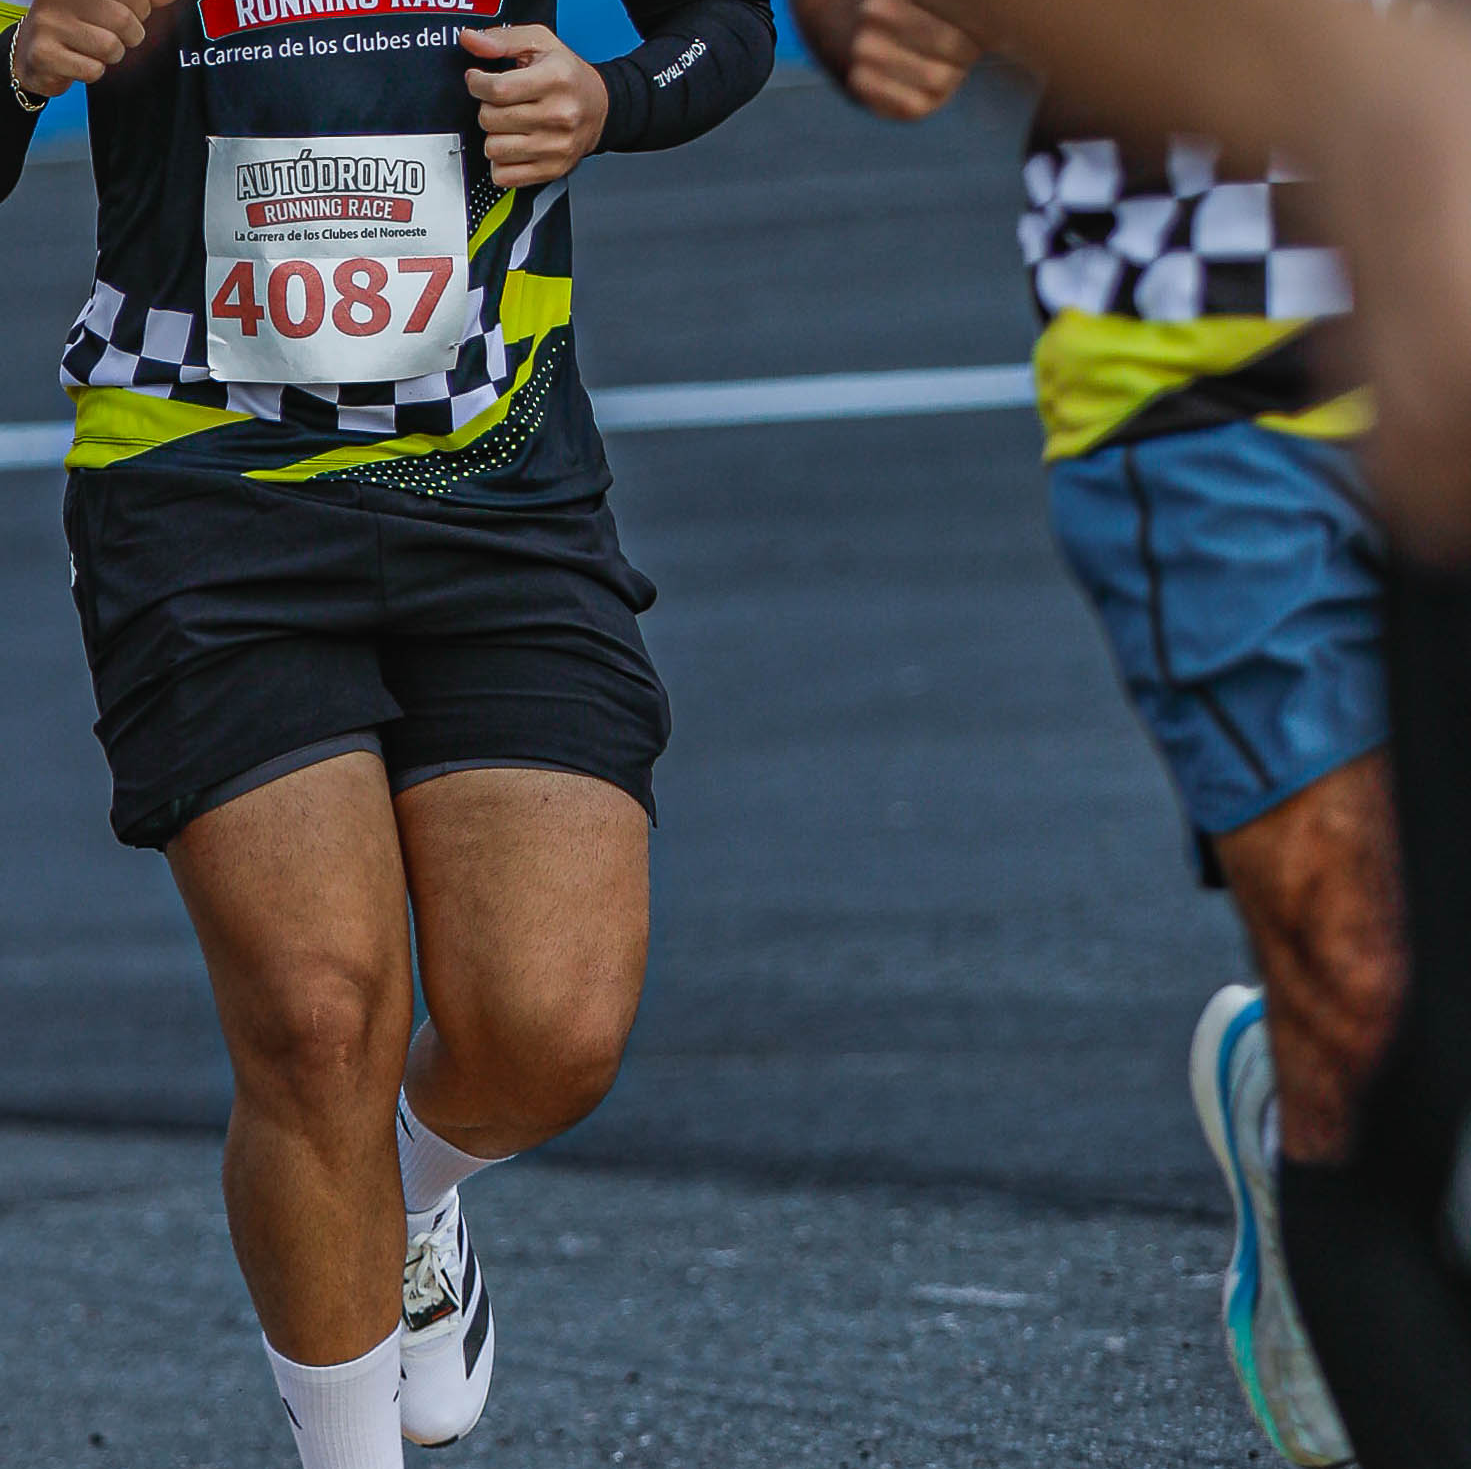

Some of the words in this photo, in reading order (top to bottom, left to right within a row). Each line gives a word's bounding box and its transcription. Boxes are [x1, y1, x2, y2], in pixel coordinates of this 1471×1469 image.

[179, 50, 201, 68] La
[203, 44, 273, 66] Carrera
[279, 37, 304, 58] de
[309, 33, 338, 56] los
[342, 28, 411, 54] Clubes
[416, 24, 448, 47] del
[236, 149, 426, 201] AUTÓDROMO
[264, 198, 343, 224] RUNNING
[348, 199, 394, 220] RACE
[234, 231, 246, 241] La
[247, 229, 285, 242] Carrera
[287, 230, 302, 241] de
[304, 229, 320, 240] los
[321, 228, 359, 240] Clubes
[360, 227, 378, 238] del
[379, 227, 427, 238] Noroeste
[211, 257, 454, 339] 4087
